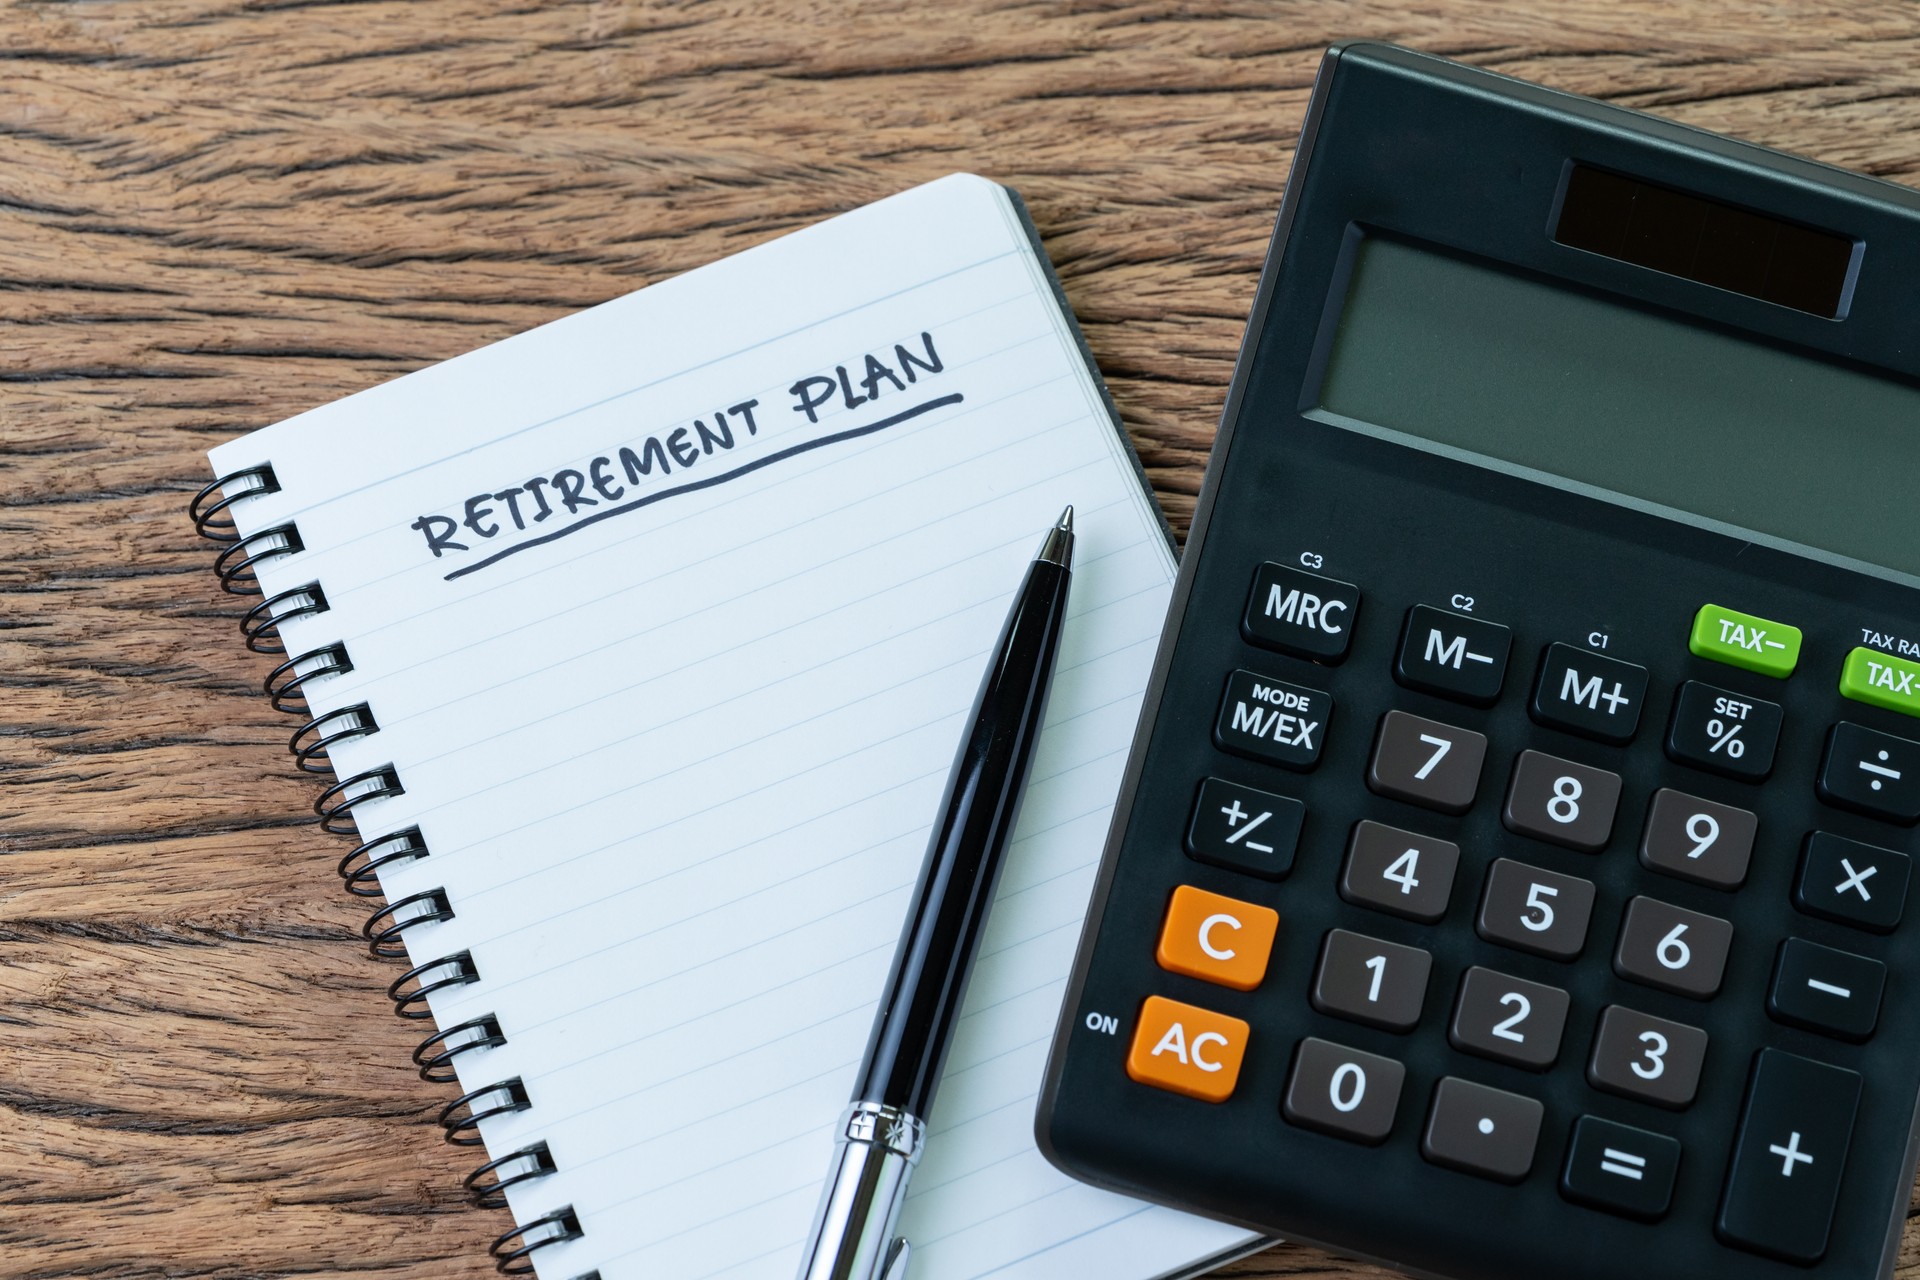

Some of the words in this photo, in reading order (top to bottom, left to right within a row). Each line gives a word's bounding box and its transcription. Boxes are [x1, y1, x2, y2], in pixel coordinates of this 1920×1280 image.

[411, 399, 758, 557] RETIREMENT
[788, 332, 944, 422] PLAN
[1299, 552, 1322, 570] C3
[1265, 584, 1347, 633] MRC
[1452, 594, 1474, 611] C2
[1589, 632, 1608, 648] C1
[1861, 628, 1894, 650] TAX
[1253, 684, 1310, 710] MODE
[1560, 668, 1629, 714] M+
[1867, 661, 1920, 695] TAX
[1232, 703, 1317, 749] M/EX
[1714, 698, 1751, 718] SET
[1415, 734, 1451, 779] 7
[1707, 718, 1745, 757] %
[1547, 777, 1582, 822] 8
[1686, 814, 1719, 858] 9
[1384, 849, 1419, 894] 4
[1521, 883, 1557, 931] 5
[1199, 914, 1241, 960] C
[1657, 924, 1690, 969] 6
[1366, 956, 1386, 1001] 1
[1087, 1013, 1118, 1034] ON
[1493, 993, 1530, 1042] 2
[1152, 1023, 1228, 1072] AC
[1631, 1032, 1667, 1079] 3
[1331, 1063, 1365, 1111] 0
